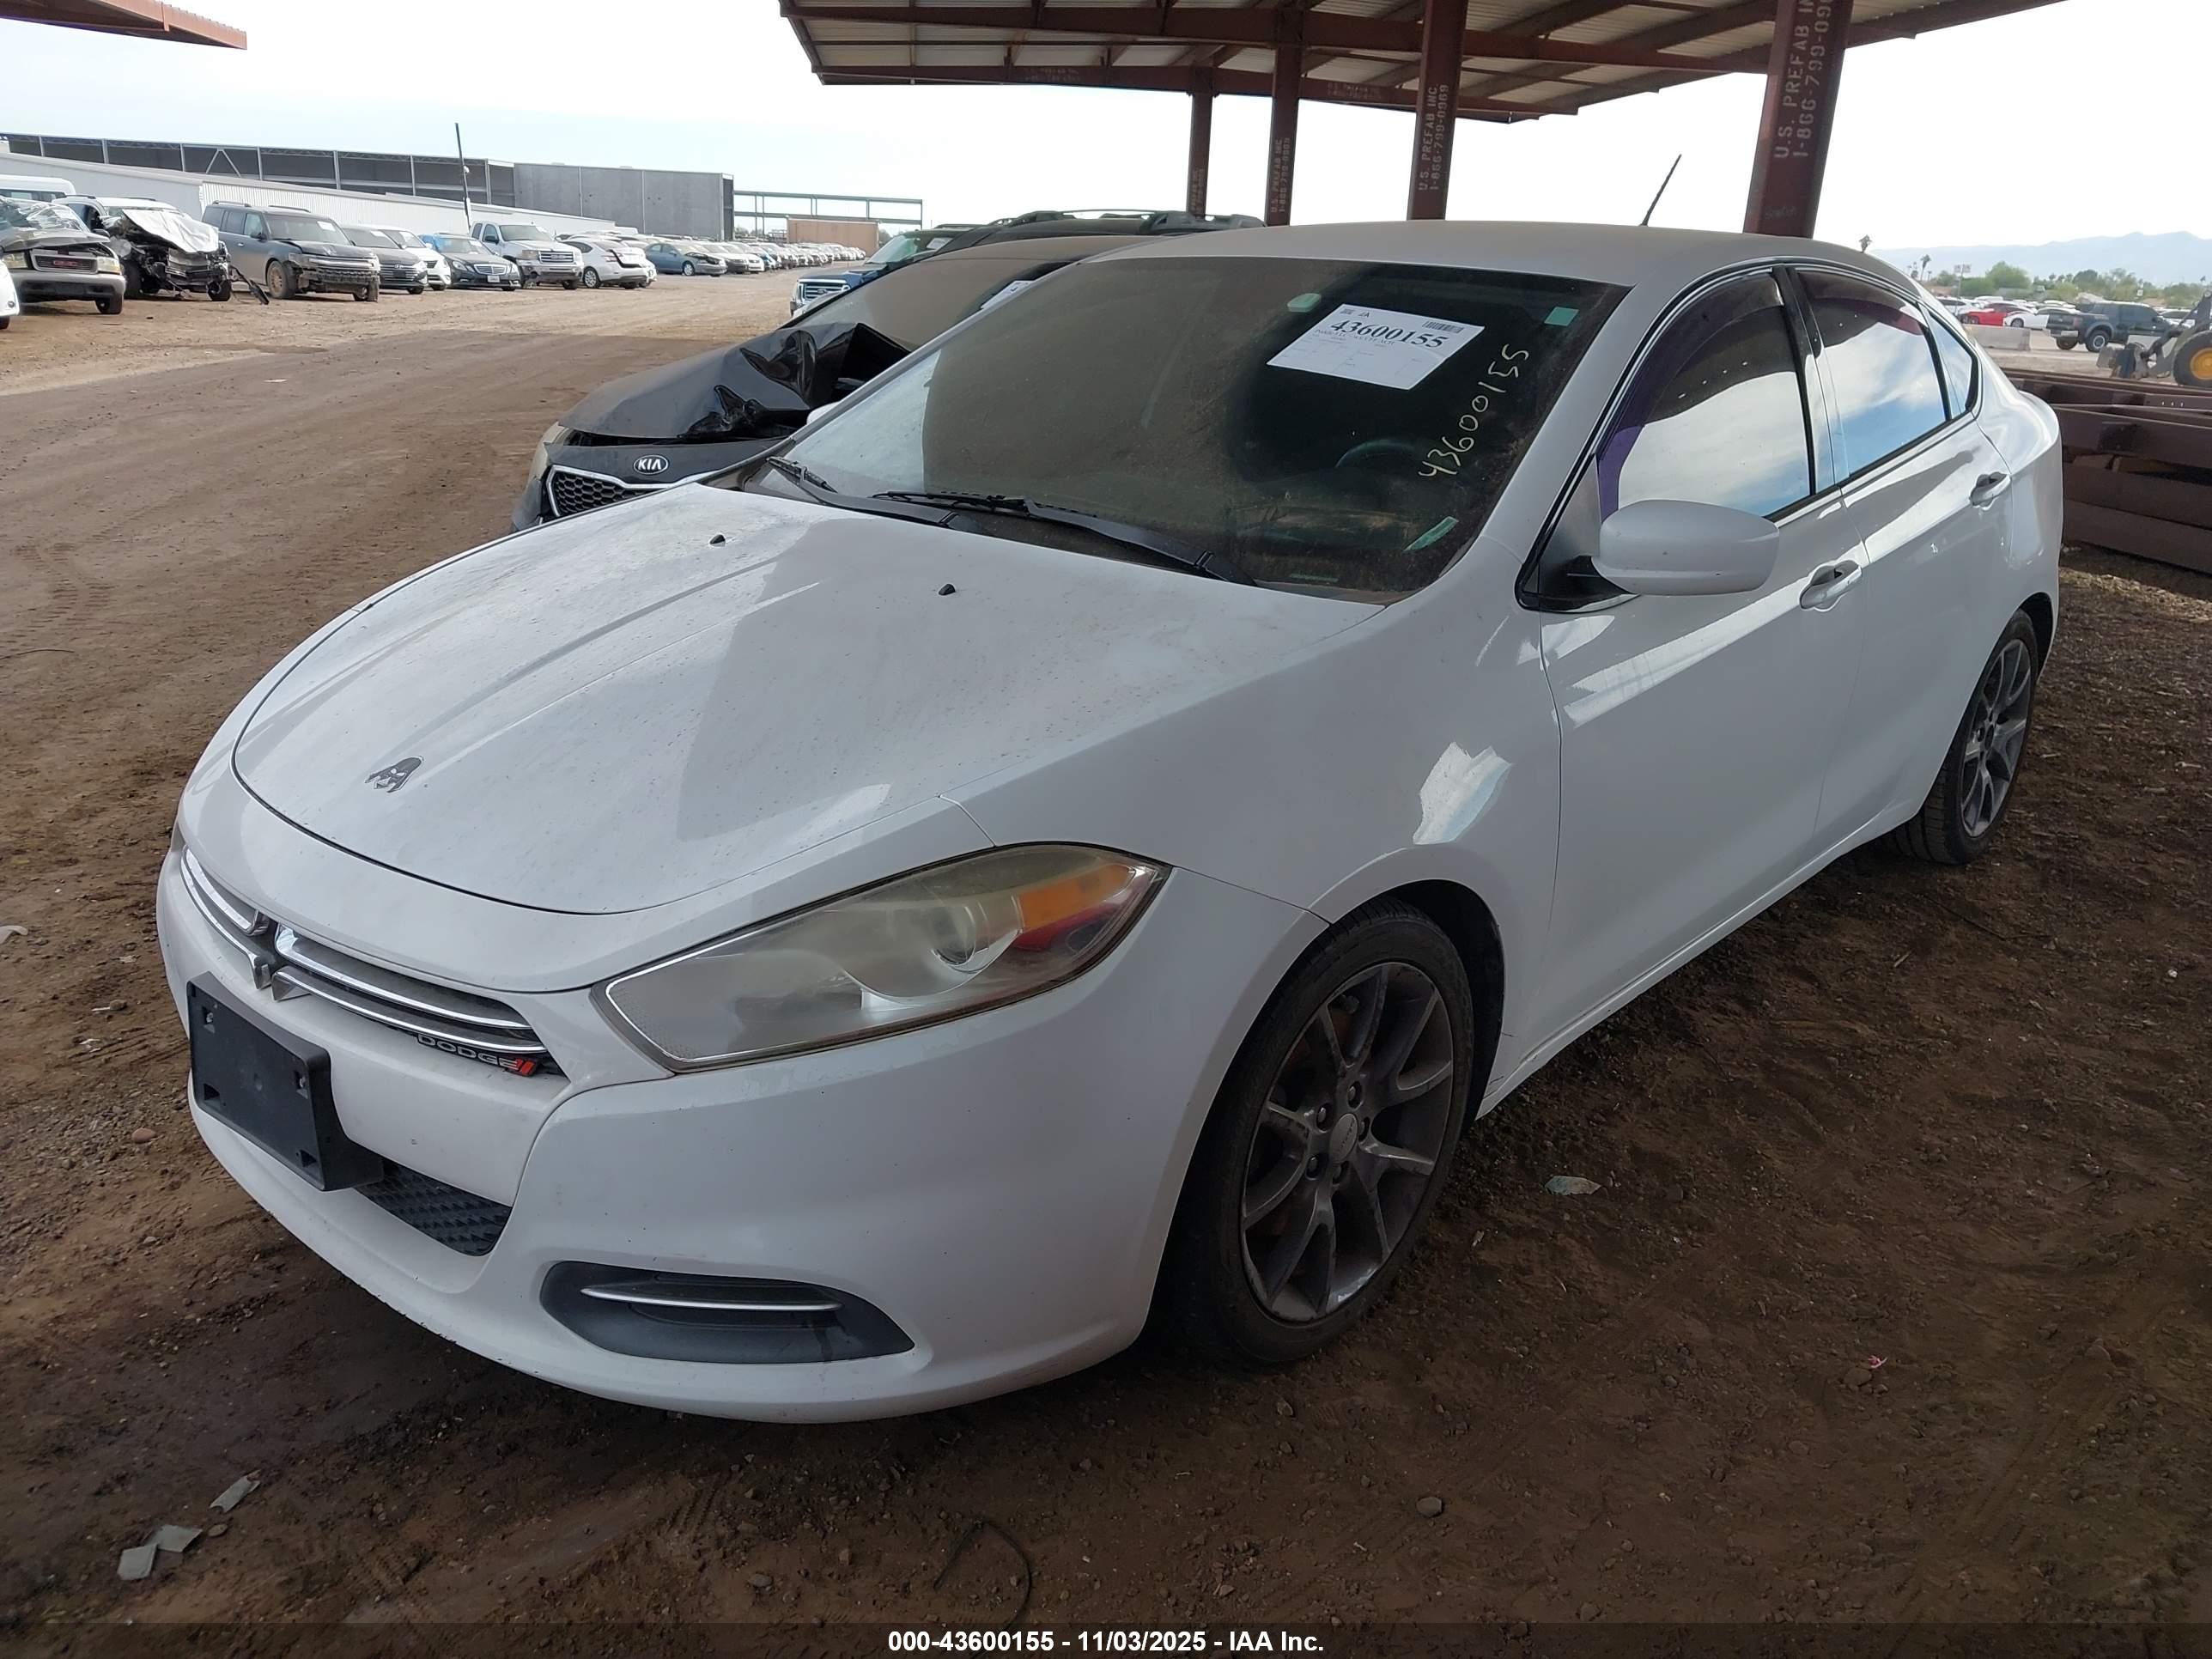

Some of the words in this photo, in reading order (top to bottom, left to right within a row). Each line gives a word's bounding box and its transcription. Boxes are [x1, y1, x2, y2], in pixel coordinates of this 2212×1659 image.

[1783, 24, 1809, 107] PREFAB
[1793, 0, 1832, 157] 1-866-799-09
[1422, 112, 1435, 161] PREFAB
[1774, 119, 1795, 158] U.S.
[1331, 319, 1449, 348] 43600155
[1418, 343, 1529, 477] 43600155
[638, 459, 661, 470] KIA
[418, 1034, 522, 1072] DODGE
